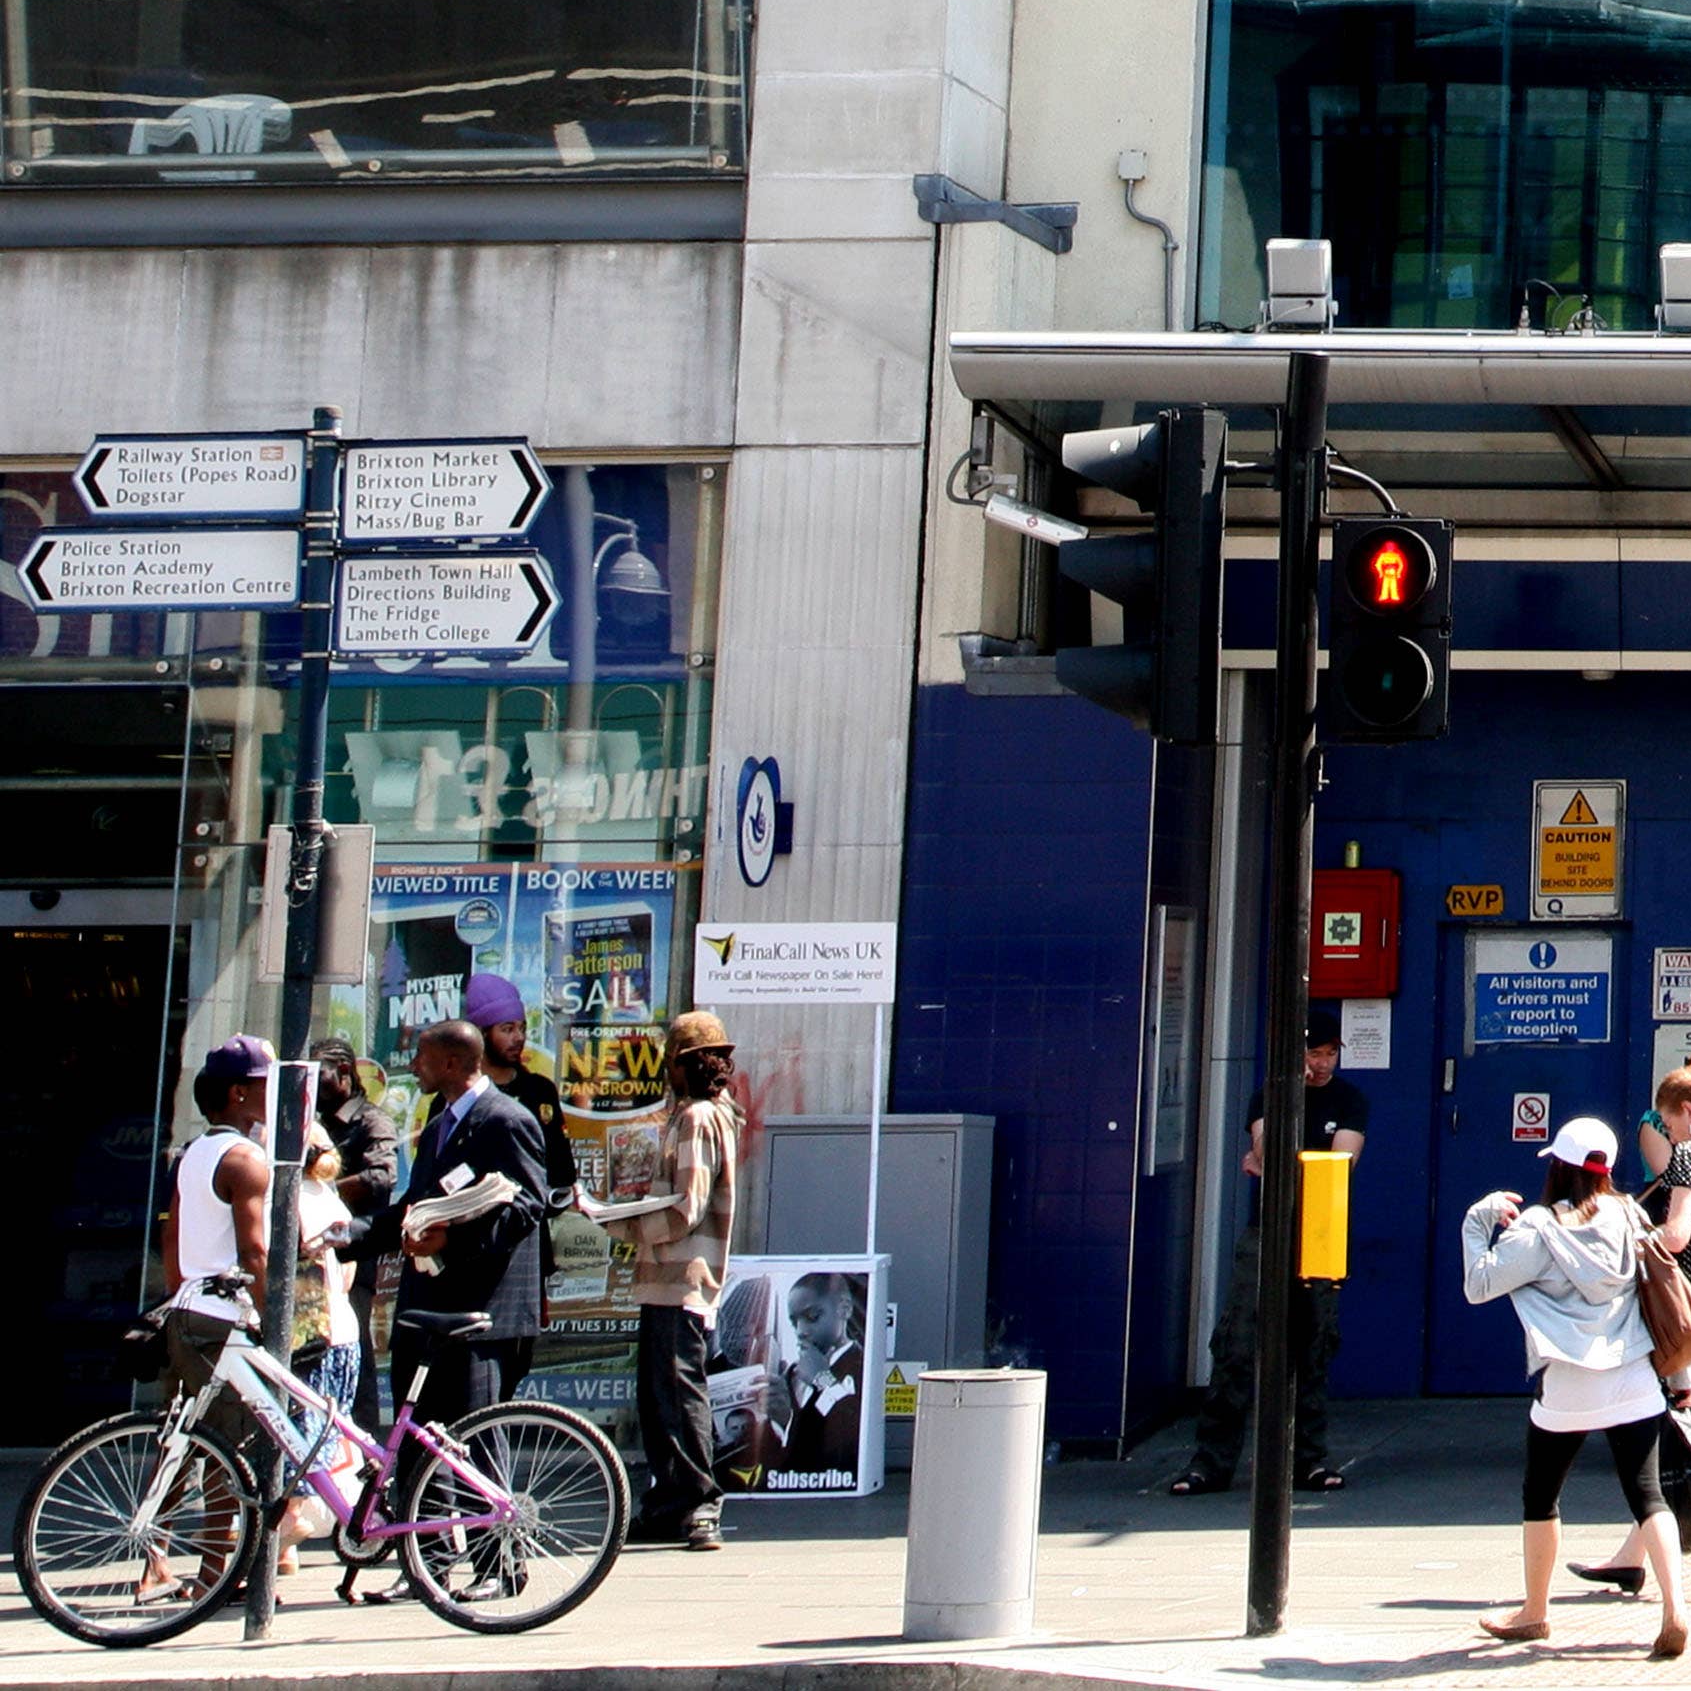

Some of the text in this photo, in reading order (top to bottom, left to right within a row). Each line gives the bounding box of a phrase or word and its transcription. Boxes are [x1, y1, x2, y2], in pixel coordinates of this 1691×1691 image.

[118, 447, 253, 466] Railway Station
[357, 451, 499, 469] Brixton Market
[119, 464, 297, 485] Toilets (Popes Road)
[356, 472, 498, 489] Brixton Library
[116, 488, 186, 505] Dogstar
[356, 492, 477, 511] Ritzy Cinema
[356, 512, 484, 530] Mass/Bug Bar
[62, 540, 181, 557] Police Station
[61, 560, 214, 578] Brixton Academy
[349, 564, 513, 581] Lambeth Town Hall
[60, 577, 292, 597] Brixton Recreation Centre
[347, 584, 511, 602] Directions Building
[347, 605, 440, 623] The Fridge
[345, 625, 490, 643] Lambeth College
[1545, 831, 1612, 843] CAUTION
[1554, 853, 1600, 862] BUILDING
[391, 865, 426, 875] RICHARD
[436, 865, 464, 875] JUDY'S
[1567, 865, 1587, 875] SITE
[453, 876, 500, 893] TITLE
[527, 870, 595, 890] BOOK
[1540, 878, 1614, 888] BEHIND DOORS
[1452, 890, 1499, 910] RVP
[582, 937, 624, 957] James
[740, 942, 882, 960] FinalCall News UK
[563, 951, 642, 977] Patterson
[406, 974, 464, 994] MYSTERY
[709, 970, 731, 981] Final
[734, 970, 752, 980] Call
[756, 970, 810, 983] Newspaper
[814, 970, 829, 980] On
[832, 970, 853, 980] Sale
[1489, 976, 1598, 989] All visitors and
[561, 975, 643, 1015] SAIL
[1552, 992, 1589, 1005] must
[388, 989, 461, 1028] MAN
[1510, 1007, 1575, 1023] report to
[570, 1026, 632, 1039] PRE-ORDER
[1507, 1023, 1578, 1037] reception
[561, 1038, 665, 1079] NEW
[561, 1080, 663, 1097] DAN BROWN
[574, 1234, 598, 1247] DAN
[563, 1247, 604, 1259] BROWN
[571, 1319, 601, 1331] TUES
[605, 1319, 617, 1331] 15
[512, 1383, 554, 1400] EAL
[766, 1468, 857, 1490] Subscribe.
